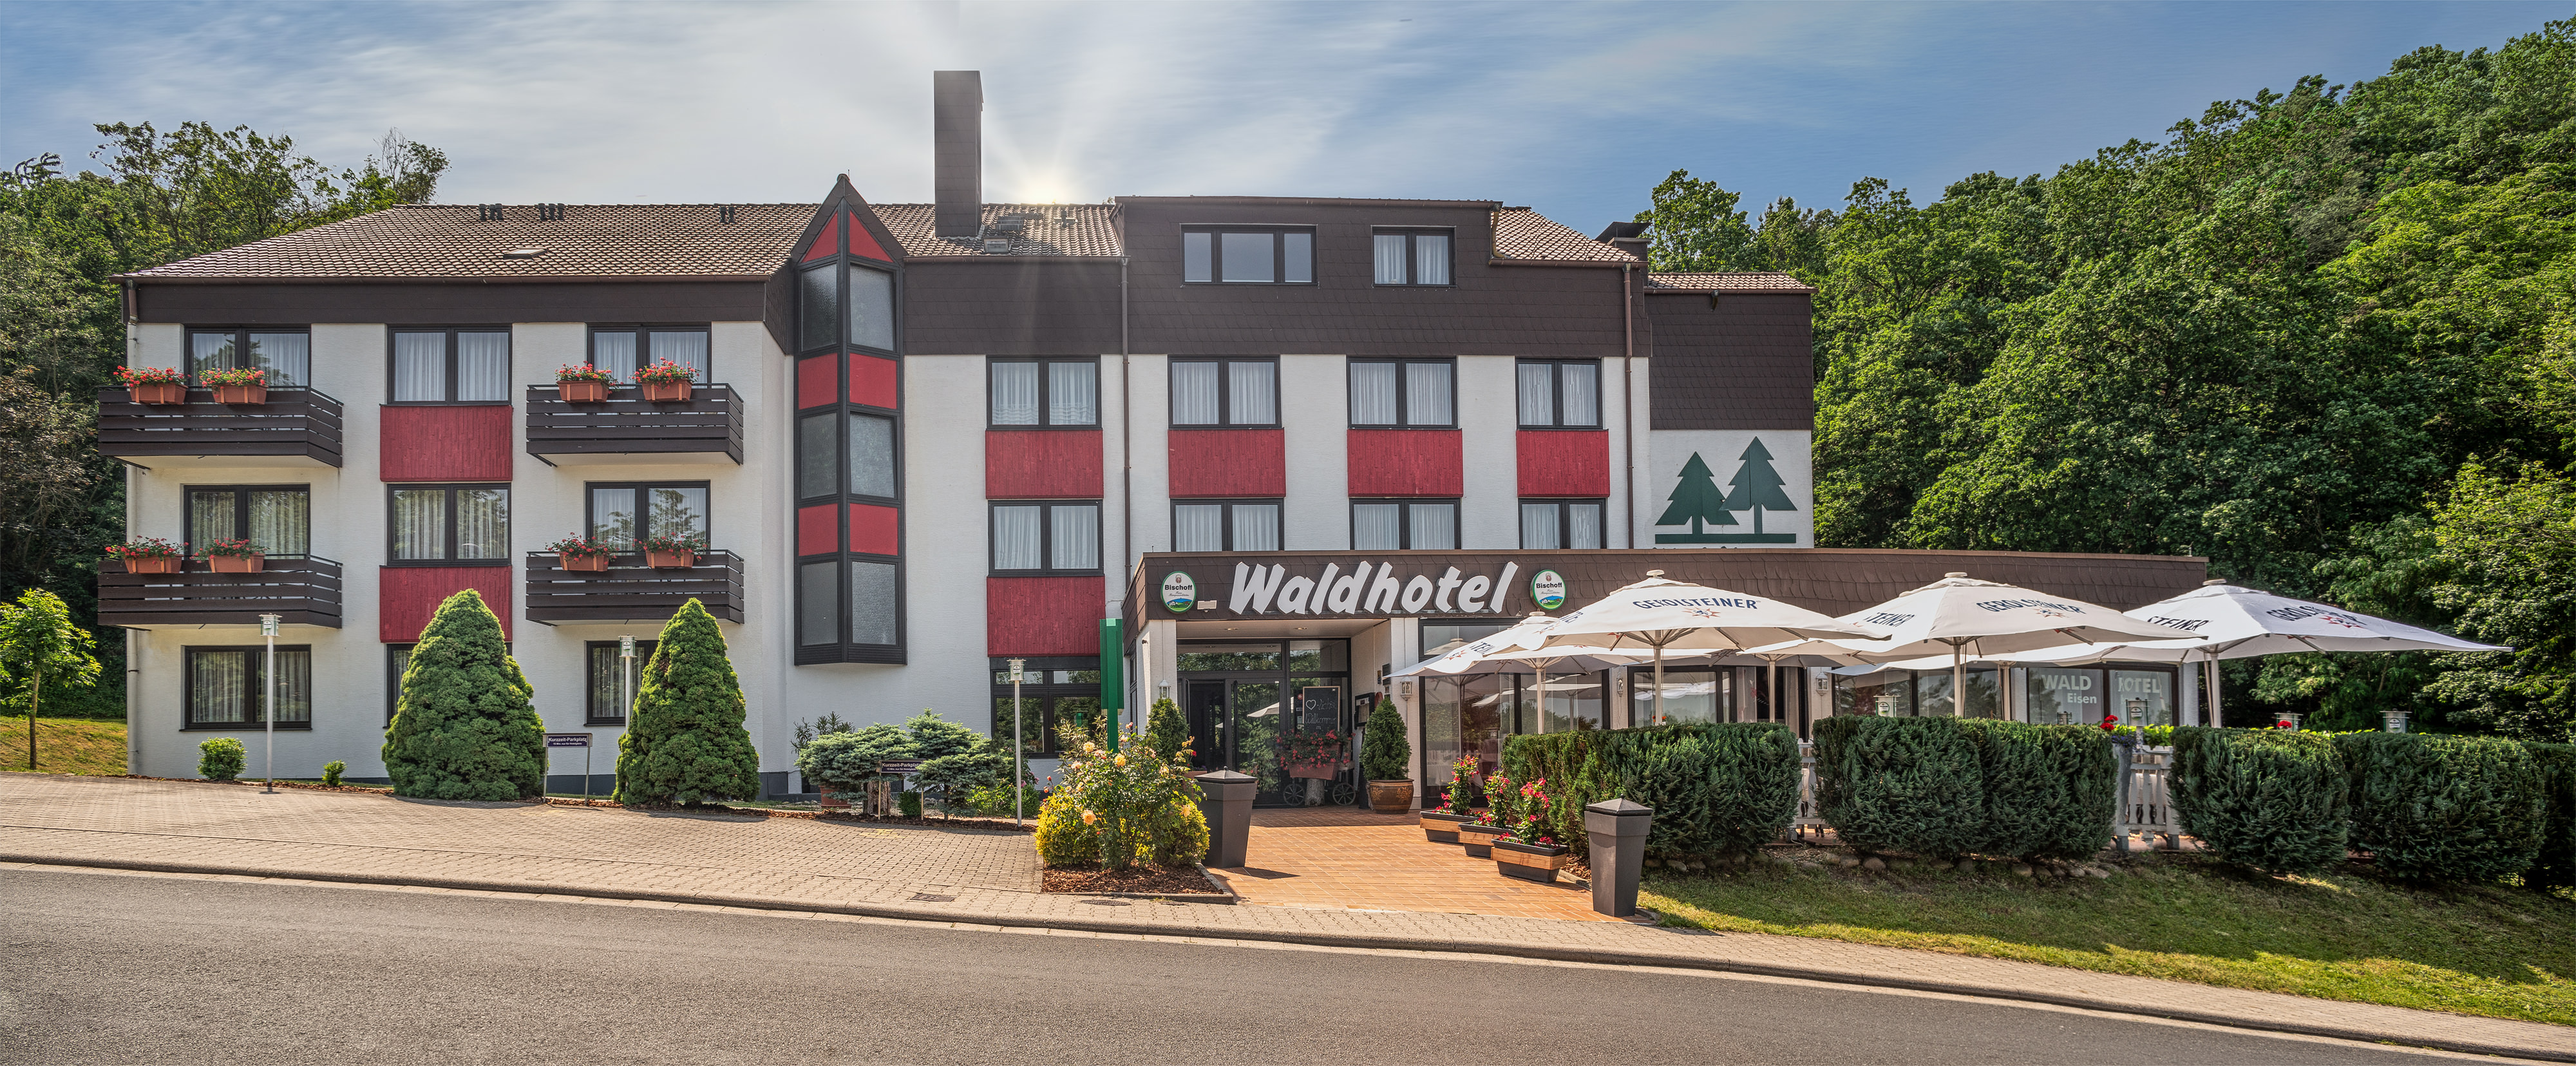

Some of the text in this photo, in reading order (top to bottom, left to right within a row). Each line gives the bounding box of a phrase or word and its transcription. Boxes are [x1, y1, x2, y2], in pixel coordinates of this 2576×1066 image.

[1229, 560, 1519, 614] Waldhotel
[1633, 598, 1757, 609] GEROLSTEINER
[2266, 605, 2368, 625] GEROLSR
[2041, 675, 2092, 690] WALD
[2067, 693, 2098, 704] Eisen
